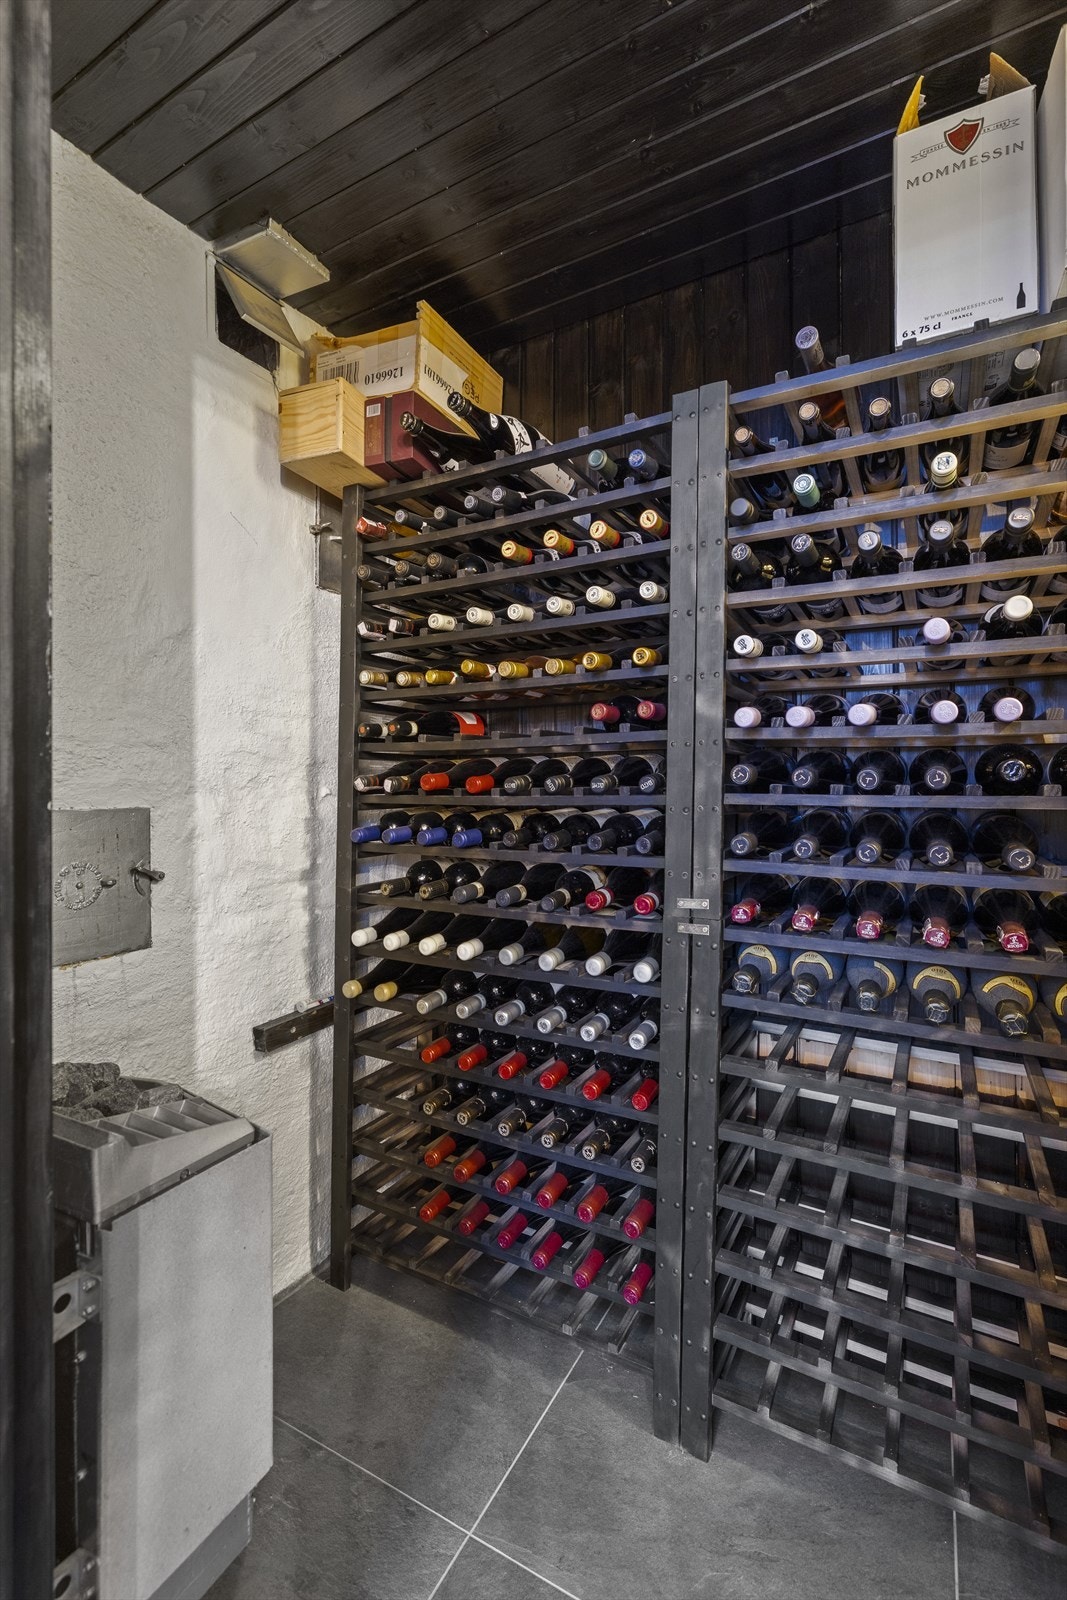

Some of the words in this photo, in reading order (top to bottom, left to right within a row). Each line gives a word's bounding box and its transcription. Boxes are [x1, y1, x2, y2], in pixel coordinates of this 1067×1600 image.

[906, 141, 1025, 190] MOMMESSIN
[951, 312, 973, 321] FRANCE
[902, 330, 908, 338] 6
[910, 329, 916, 337] x
[919, 324, 930, 334] 75
[933, 322, 941, 330] cl
[364, 366, 404, 386] 1266610
[424, 364, 455, 395] 2666101
